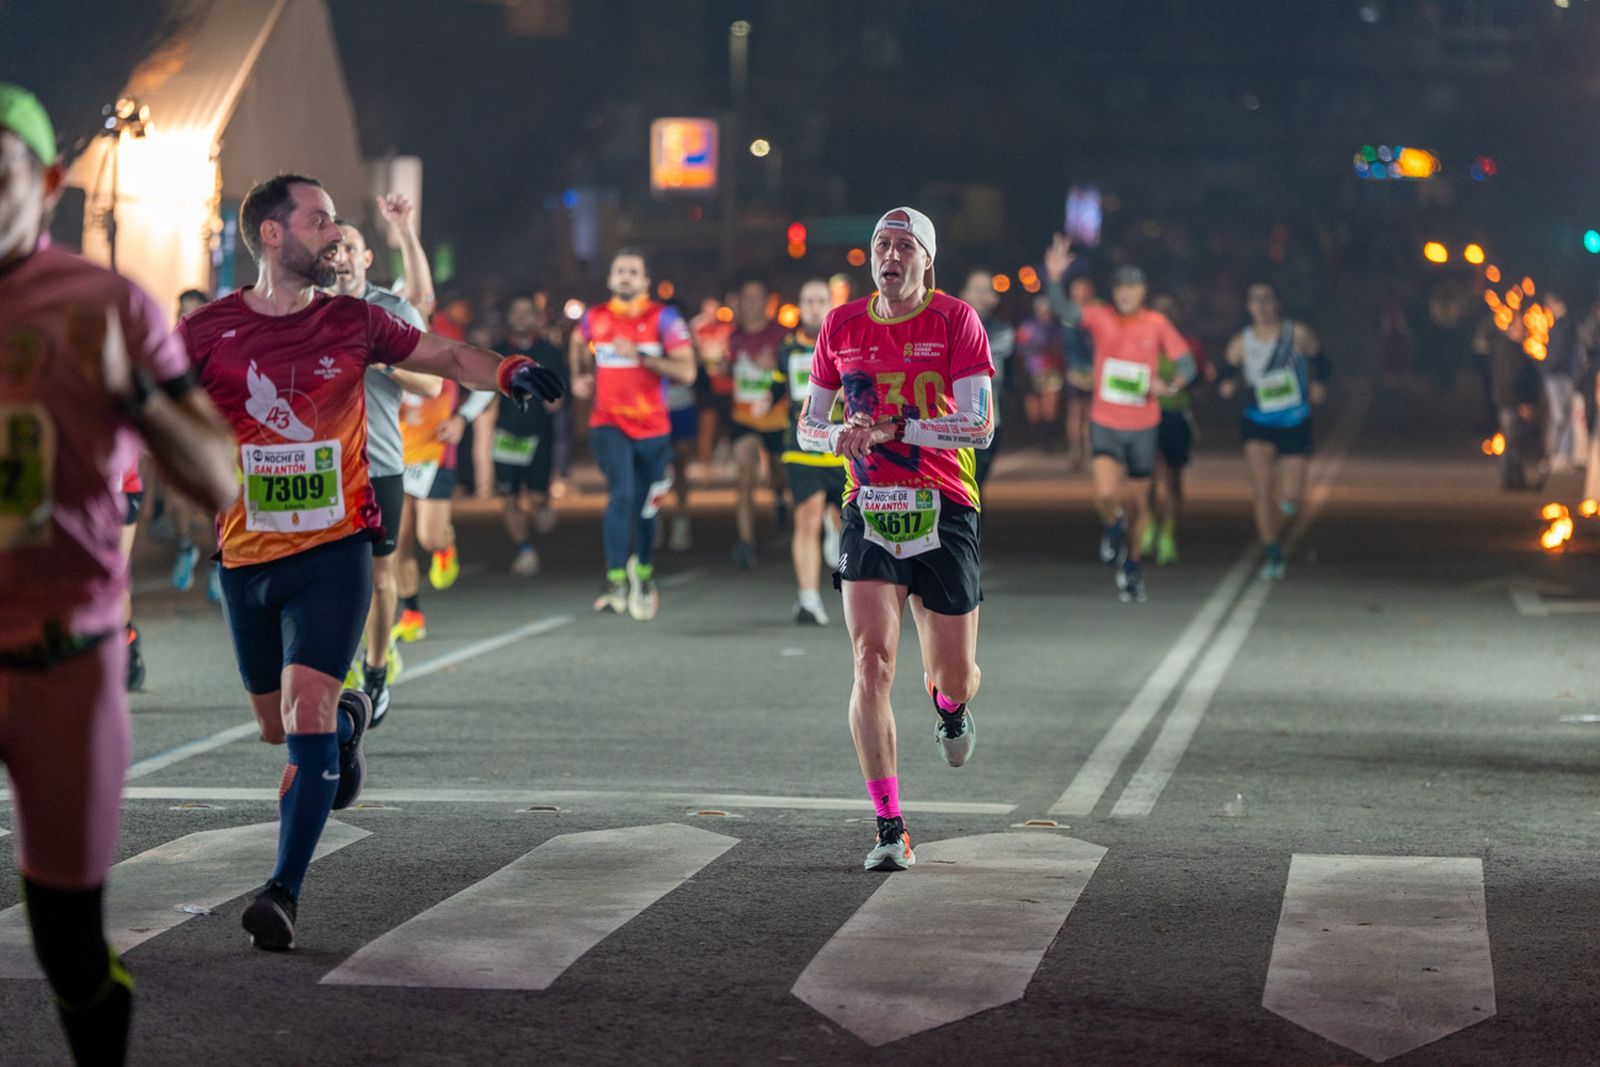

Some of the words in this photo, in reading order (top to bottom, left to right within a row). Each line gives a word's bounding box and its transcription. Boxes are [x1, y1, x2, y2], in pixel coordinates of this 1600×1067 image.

[876, 371, 945, 421] 30
[266, 406, 290, 429] 43
[264, 454, 292, 464] NOCHE
[295, 452, 305, 462] DE
[254, 464, 272, 474] SAN
[261, 473, 324, 503] 7309
[898, 492, 908, 501] DE
[864, 502, 880, 511] SAN
[880, 501, 909, 511] ANTÓN
